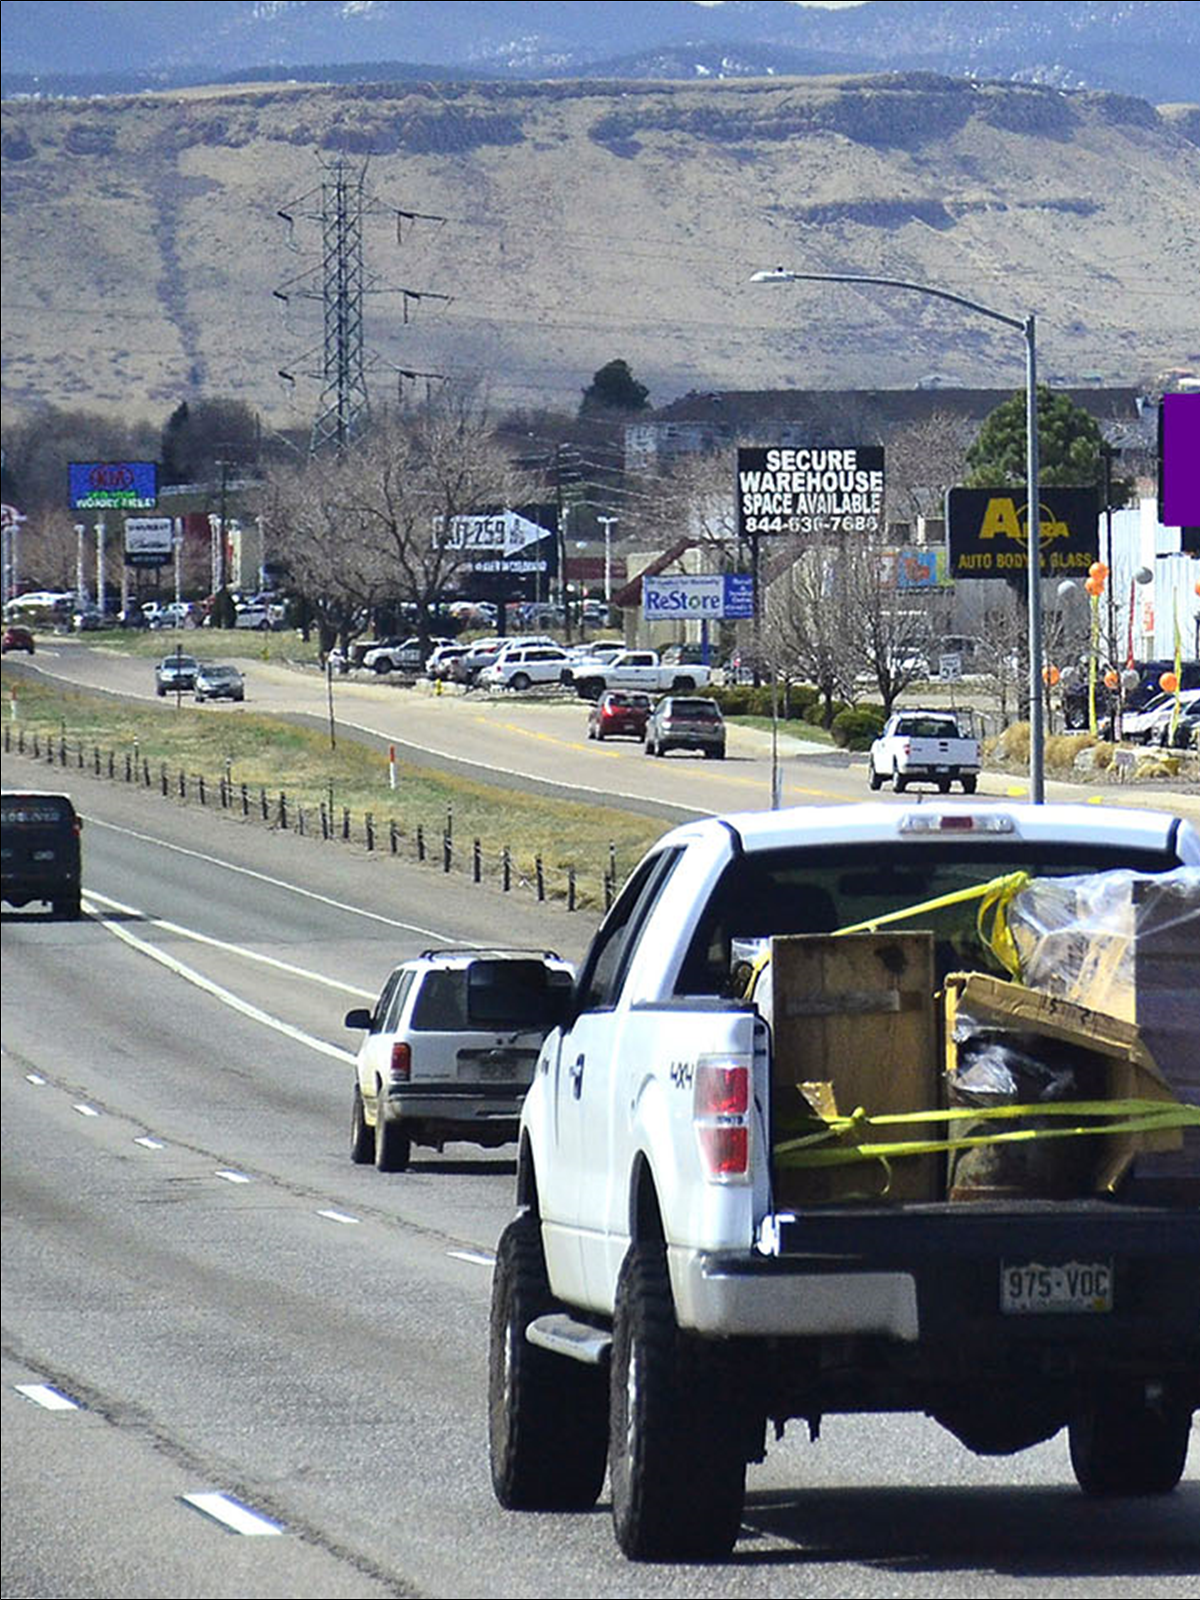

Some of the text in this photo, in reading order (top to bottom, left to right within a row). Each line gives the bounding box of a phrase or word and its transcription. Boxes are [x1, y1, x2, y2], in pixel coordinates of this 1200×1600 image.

[766, 449, 857, 472] SECURE
[739, 471, 884, 493] WAREHOUSE
[742, 492, 881, 515] SPACE AVAILABLE
[474, 520, 505, 545] 259
[958, 553, 992, 568] AUTO
[1050, 552, 1092, 567] GLASS
[647, 590, 720, 610] ReStore
